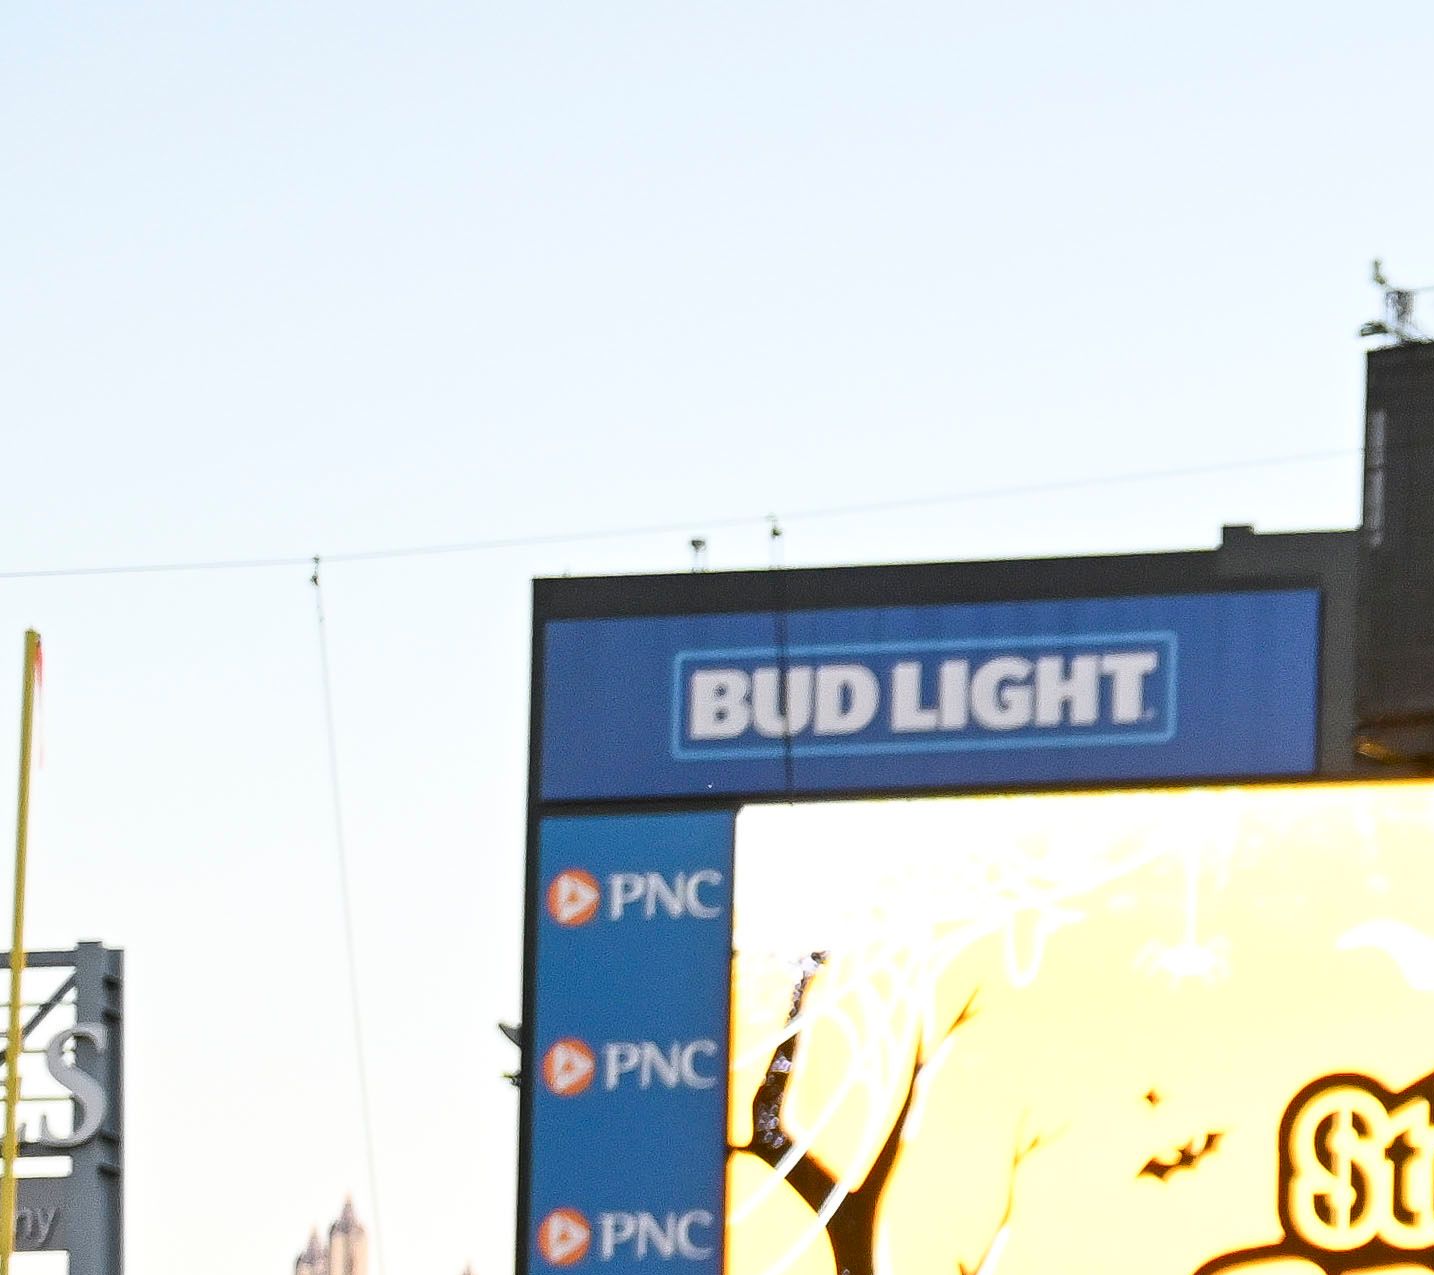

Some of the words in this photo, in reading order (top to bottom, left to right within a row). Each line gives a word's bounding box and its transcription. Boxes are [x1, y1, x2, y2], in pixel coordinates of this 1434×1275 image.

[688, 664, 880, 742] BUD
[891, 651, 1158, 736] LIGHT
[607, 869, 723, 921] PNC
[604, 1039, 717, 1089] PNC
[600, 1210, 714, 1261] PNC
